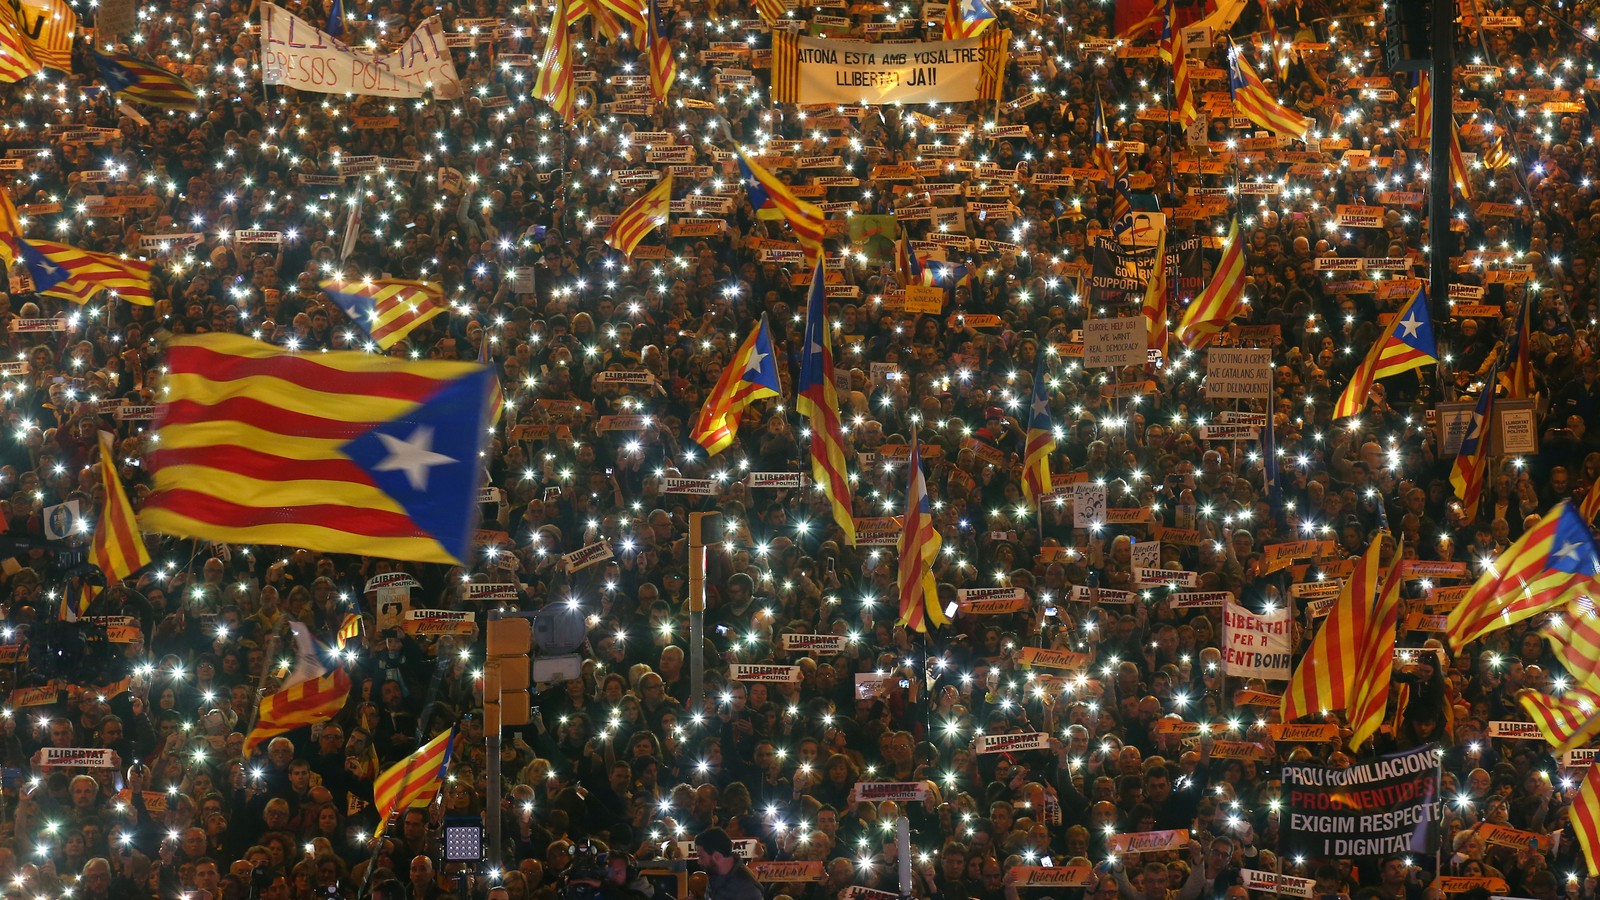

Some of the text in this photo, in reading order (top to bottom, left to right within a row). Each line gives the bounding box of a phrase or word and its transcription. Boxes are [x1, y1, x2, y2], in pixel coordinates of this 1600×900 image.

[799, 48, 838, 64] AITONA
[845, 52, 875, 65] ESTA
[882, 53, 907, 65] AMB
[907, 67, 937, 87] JA!!
[1341, 215, 1377, 223] LLIBERTAT
[1093, 276, 1138, 291] SUPPORT
[1089, 323, 1109, 331] EUROPE
[1111, 322, 1124, 331] HELP
[1113, 332, 1131, 340] WANT
[1106, 342, 1139, 352] DEMOCRACY
[1104, 354, 1127, 363] JUSTICE
[1210, 353, 1271, 364] IS VOTING A CRIME?
[605, 372, 647, 380] LLIBERTAT
[1209, 368, 1269, 379] WE CATALANS ARE
[1209, 382, 1269, 393] NOT DELINQUENTS
[754, 473, 799, 481] LLIBERTAT
[667, 480, 711, 488] LLIBERTAT
[569, 544, 606, 563] LLIBERTAT
[1141, 570, 1190, 580] LLIBERTAT
[967, 588, 1016, 596] LLIBERTAT
[1178, 593, 1228, 601] LLIBERTAT
[972, 601, 1013, 612] Freedom!
[413, 611, 466, 620] LLIBERTAT
[789, 635, 840, 644] LLIBERTAT
[1234, 633, 1268, 646] PER A
[1031, 652, 1075, 666] Llibertat!
[738, 666, 791, 675] LLIBERTAT
[1281, 726, 1323, 739] Llibertat!
[985, 734, 1039, 746] LLIBERTAT
[48, 750, 104, 759] LLIBERTAT
[1282, 749, 1440, 786] PROU HUMILIACIONS
[862, 784, 918, 793] LLIBERTAT
[1290, 801, 1440, 833] EXIGIM RESPECTE
[1128, 832, 1173, 850] Llibertat!
[1324, 832, 1413, 856] I DIGNITAT
[758, 865, 807, 878] Freedom!
[1028, 870, 1075, 885] Llibertat!
